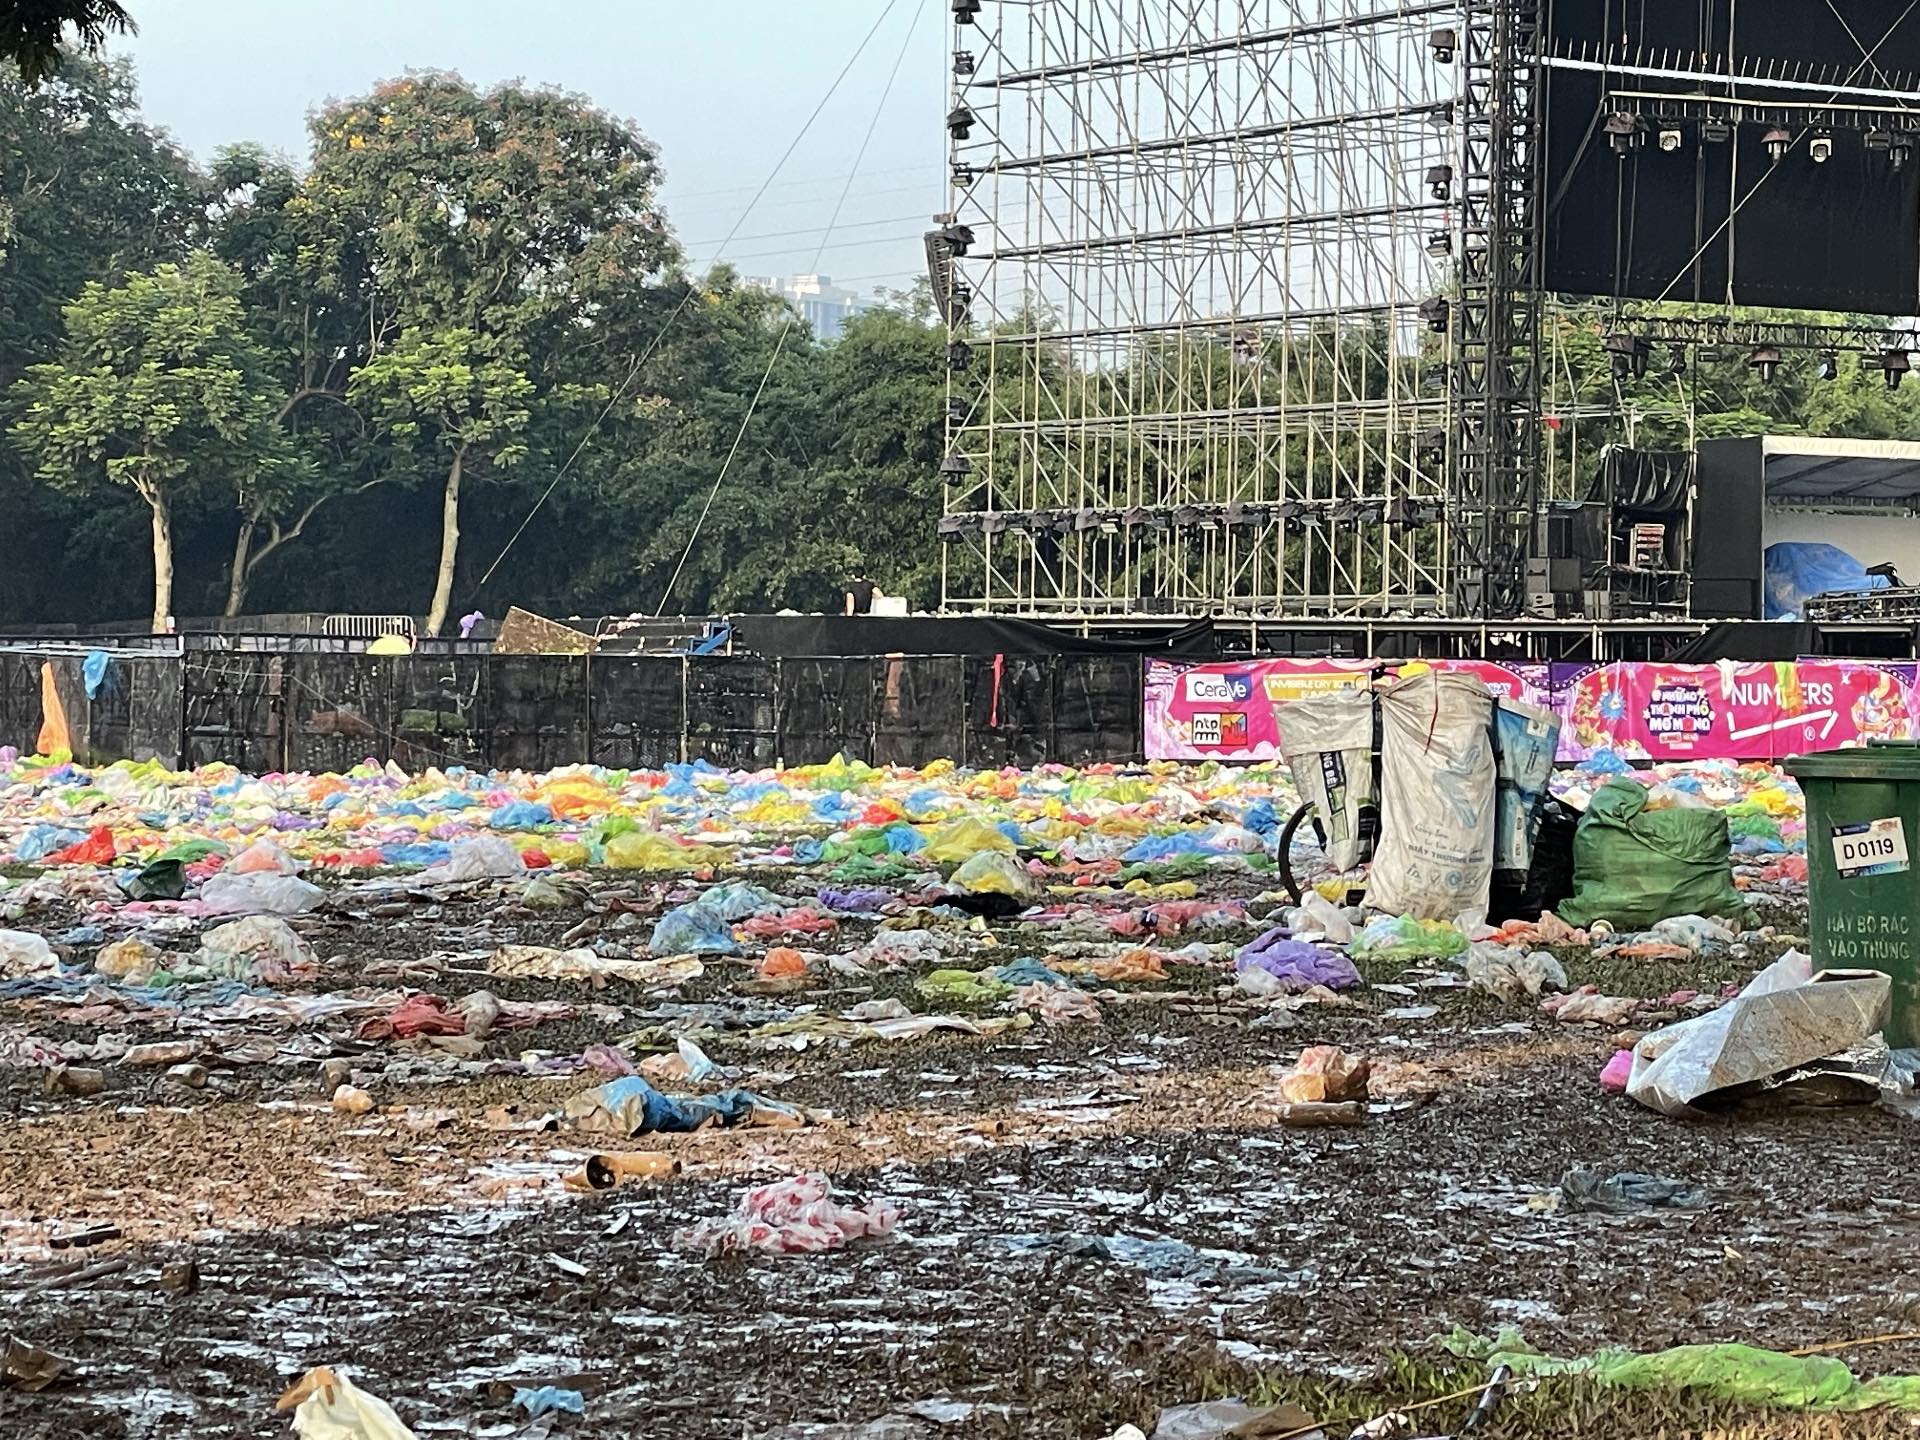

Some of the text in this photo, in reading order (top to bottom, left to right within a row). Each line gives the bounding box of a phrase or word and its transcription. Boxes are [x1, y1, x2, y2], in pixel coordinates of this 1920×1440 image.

[1193, 681, 1247, 698] CeraVe
[1731, 682, 1834, 706] NUMERS
[1844, 838, 1894, 859] D 0119
